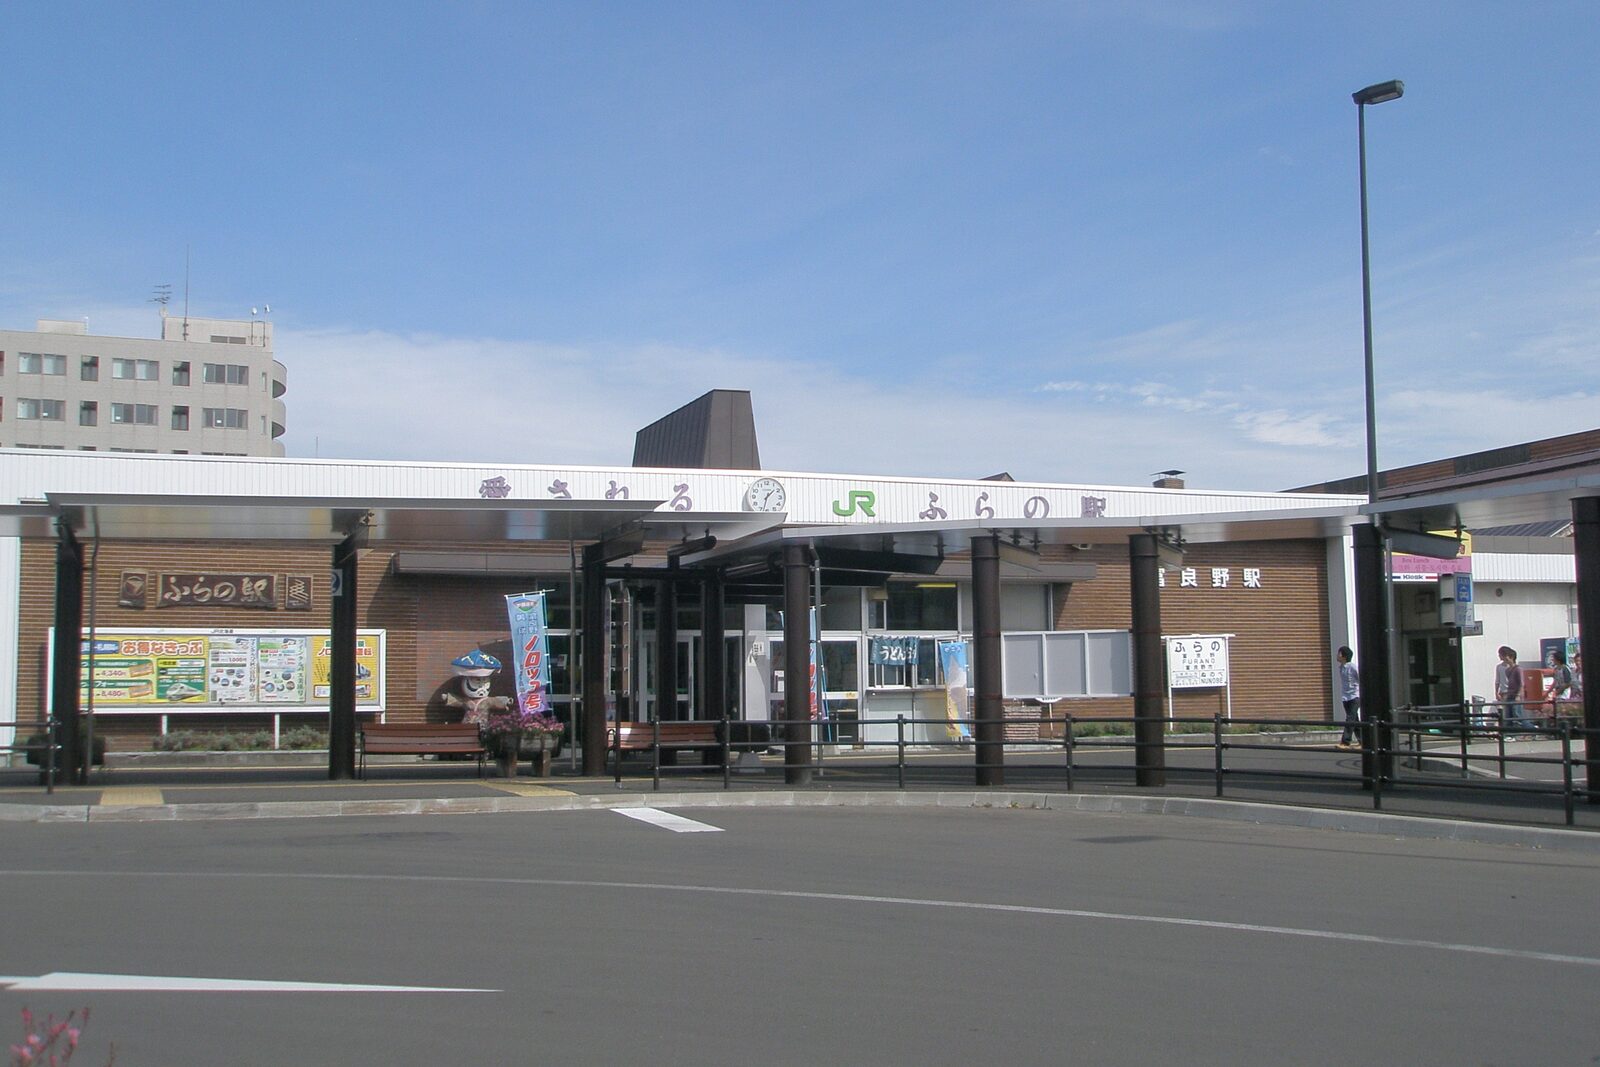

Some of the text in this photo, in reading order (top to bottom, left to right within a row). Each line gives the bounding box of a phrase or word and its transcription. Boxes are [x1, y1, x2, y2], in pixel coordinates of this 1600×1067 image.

[832, 490, 876, 518] JR
[919, 491, 1107, 519] ふらの駅
[163, 576, 269, 602] ふらの駅
[121, 640, 204, 656] お得なきっぷ
[1174, 640, 1221, 653] ふらの
[523, 635, 542, 711] ノロッコ号
